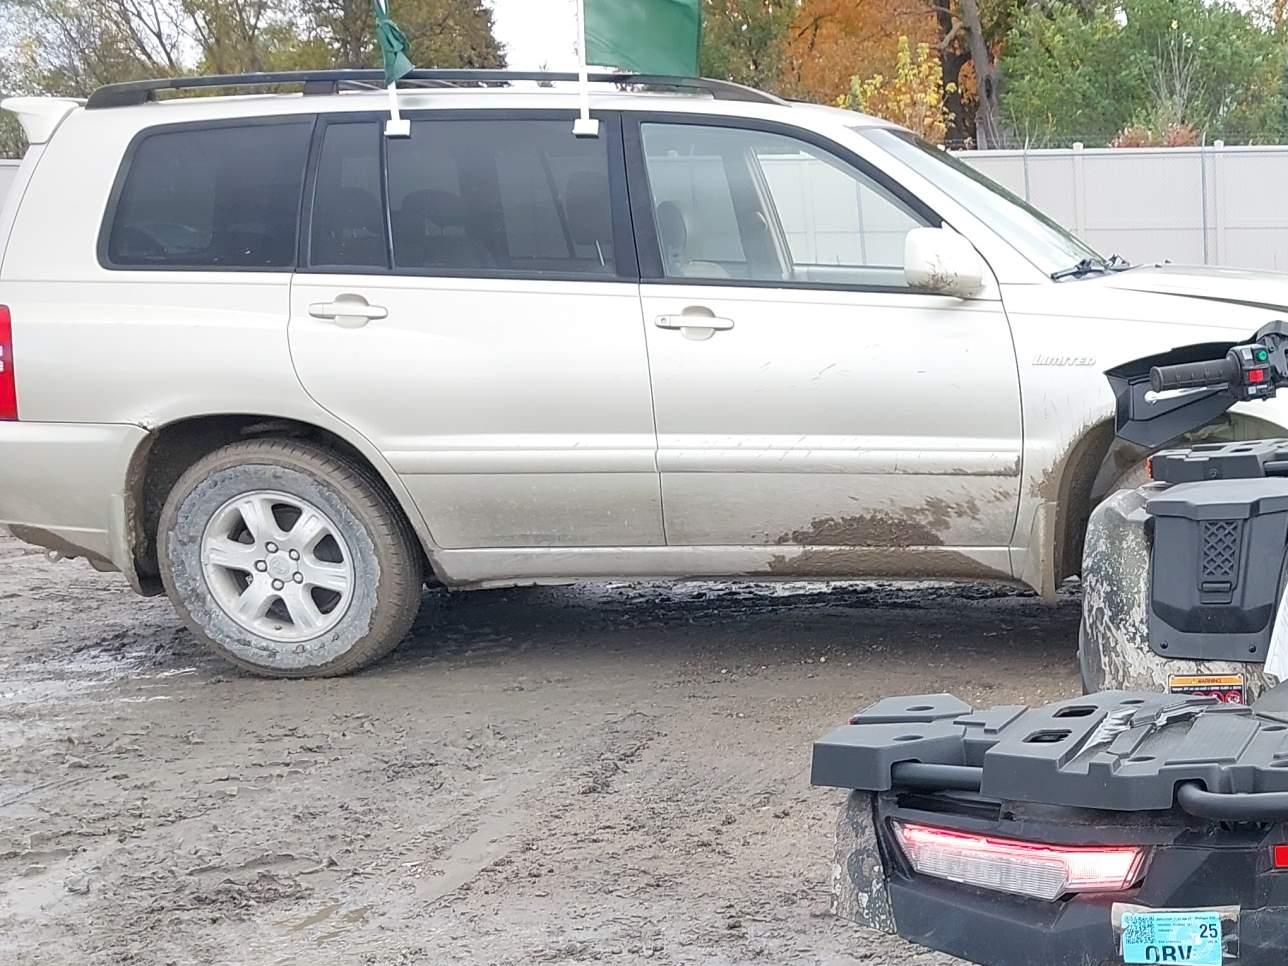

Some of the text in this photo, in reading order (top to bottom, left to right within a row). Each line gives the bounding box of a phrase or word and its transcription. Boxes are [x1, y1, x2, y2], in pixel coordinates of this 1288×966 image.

[1032, 353, 1096, 367] LIMITED
[1199, 924, 1218, 938] 25
[1145, 945, 1193, 963] ORV
